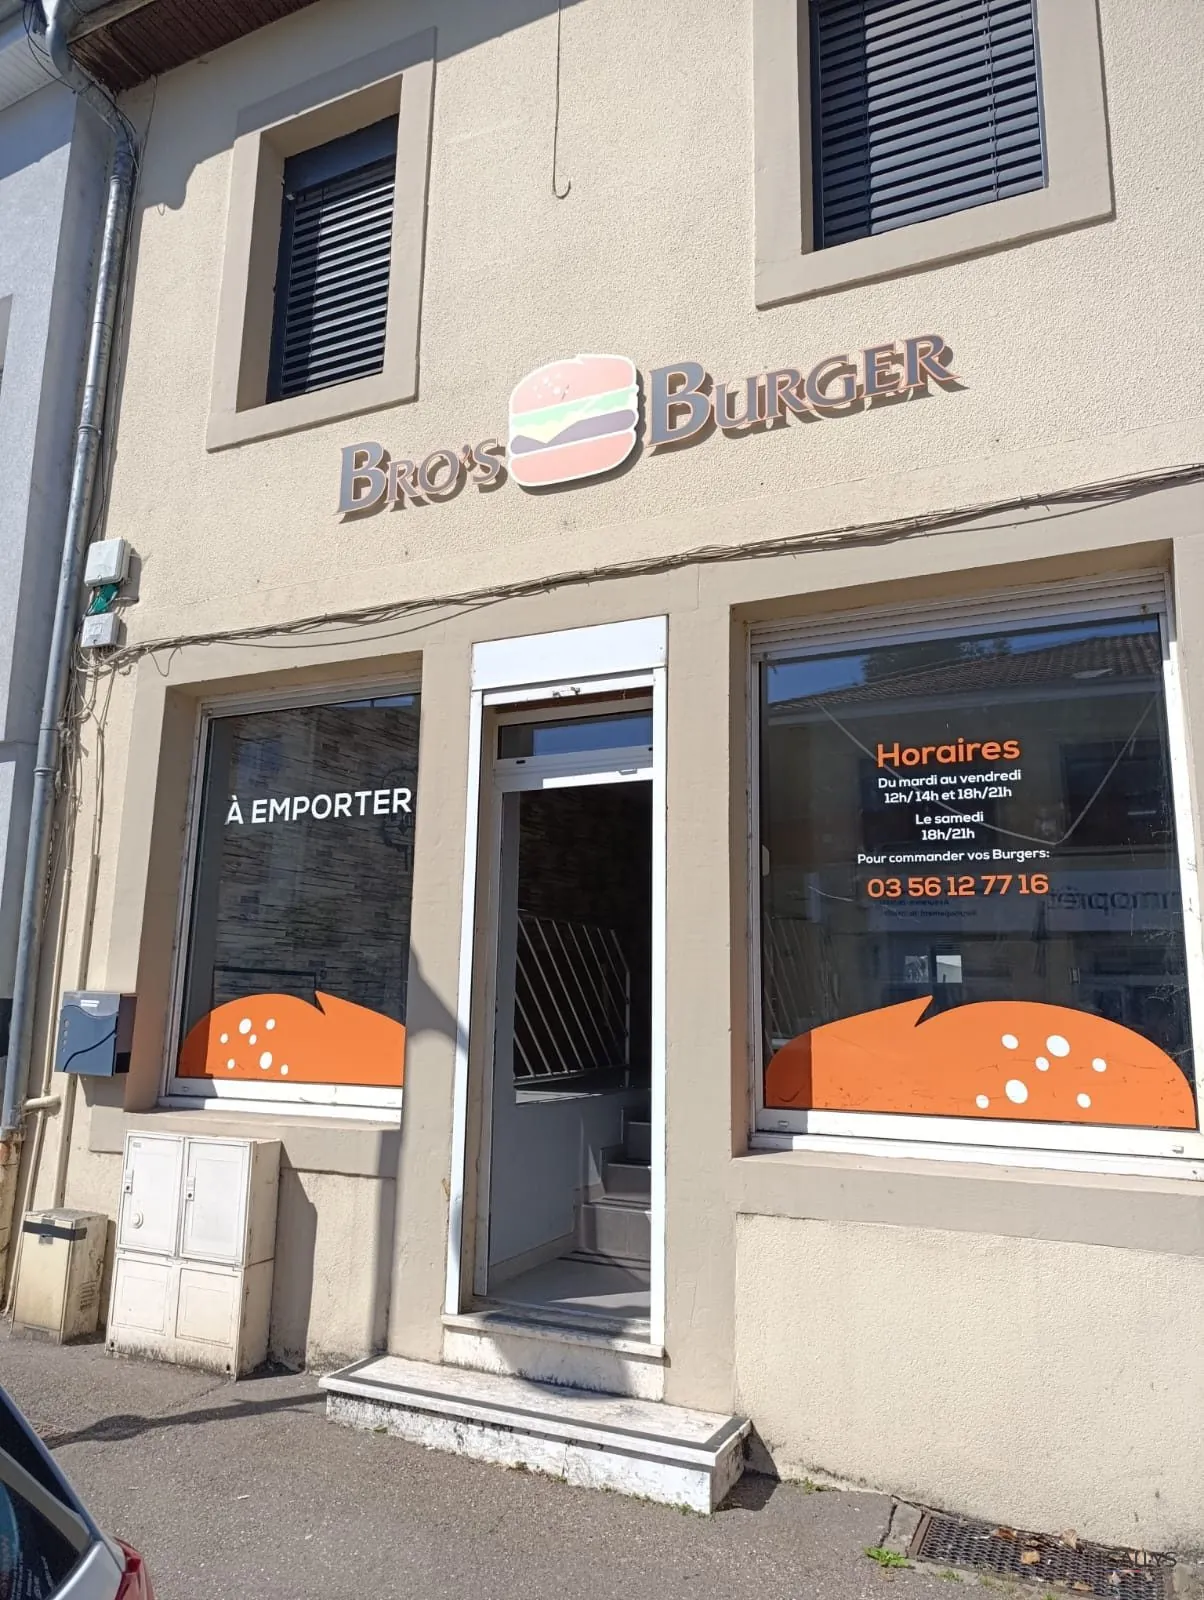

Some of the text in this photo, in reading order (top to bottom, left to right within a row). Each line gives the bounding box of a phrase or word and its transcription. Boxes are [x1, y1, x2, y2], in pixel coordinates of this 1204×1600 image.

[644, 334, 962, 448] BURGER
[877, 737, 1021, 768] Horaires
[878, 769, 1022, 788] Du mardi au vendredi
[884, 786, 1013, 804] 12h/ 14h et 18h/21h
[224, 787, 412, 826] À EMPORTER
[915, 811, 984, 825] Le samedi
[921, 828, 976, 841] 18h/21h
[857, 848, 1051, 864] Pour commander vos Burgers:
[867, 873, 1049, 898] 03 56 12 77 16
